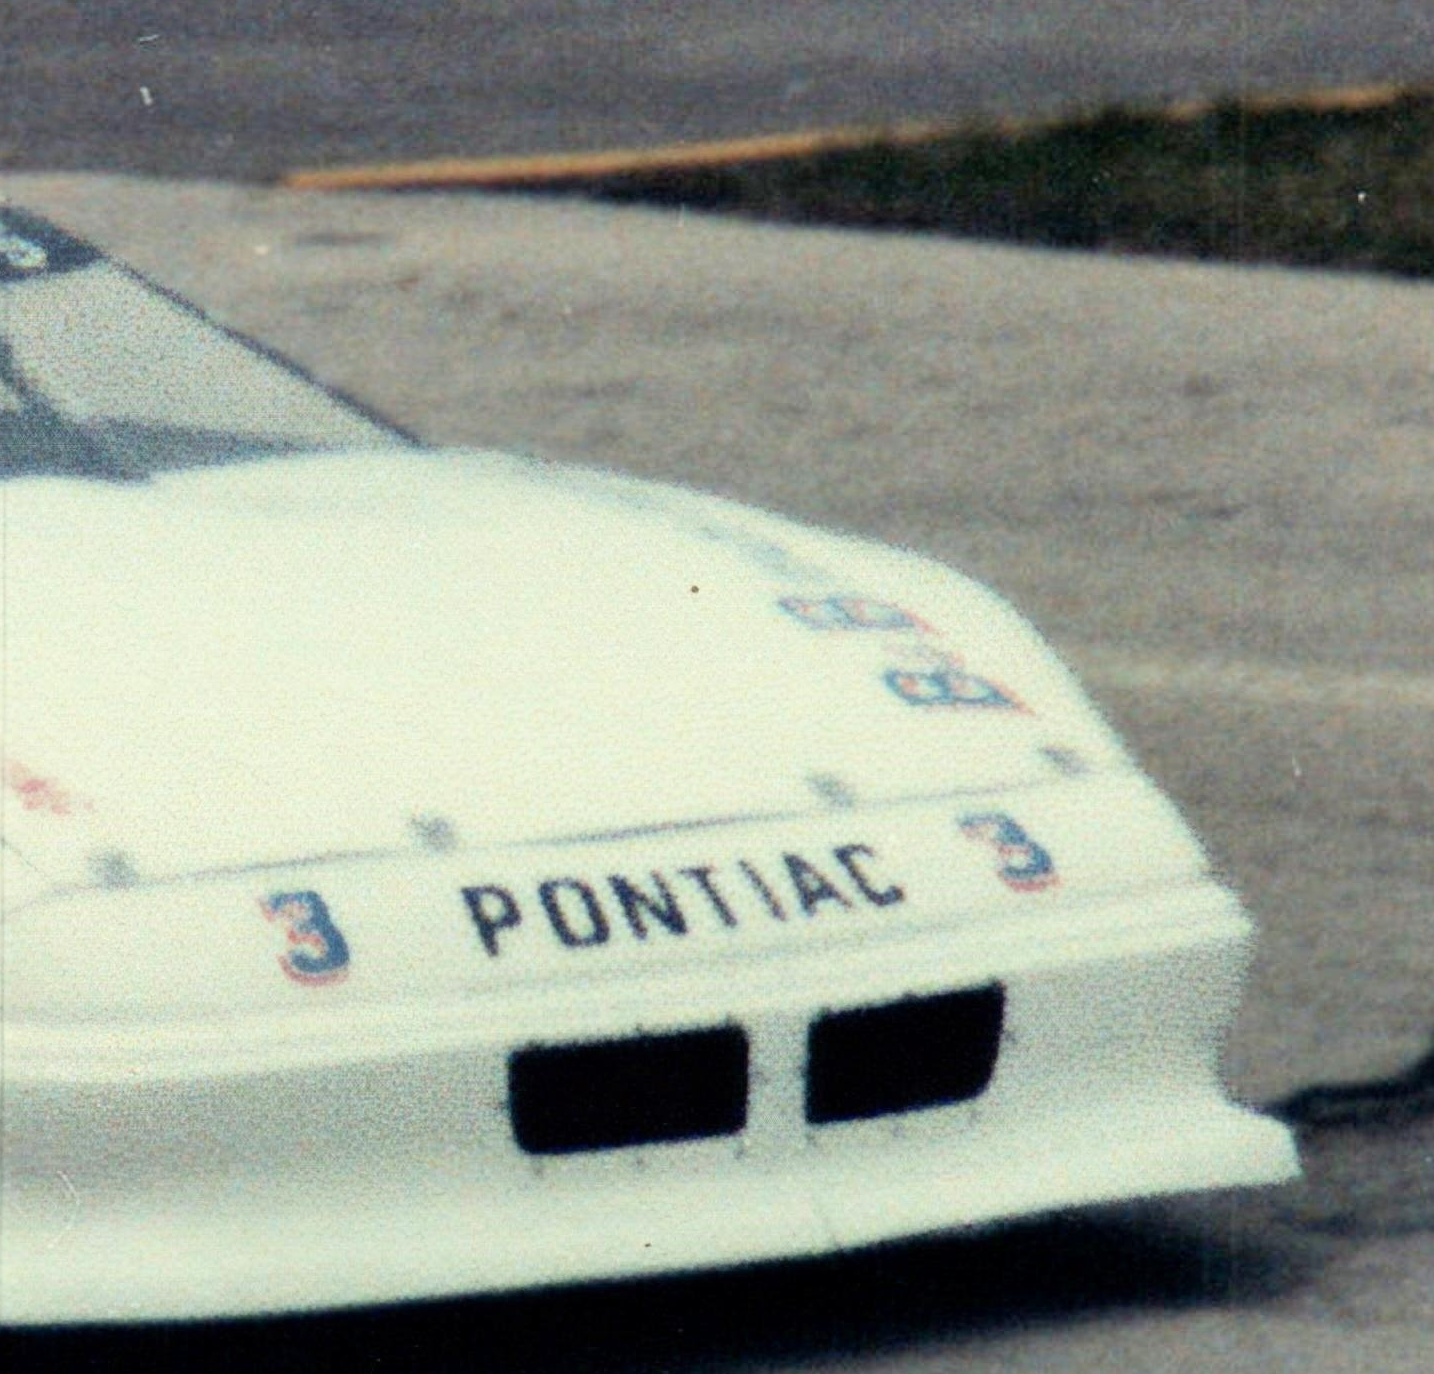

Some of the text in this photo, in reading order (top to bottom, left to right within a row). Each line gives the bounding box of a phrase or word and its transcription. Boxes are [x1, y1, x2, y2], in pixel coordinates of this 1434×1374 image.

[459, 841, 907, 958] PONTIAC
[962, 811, 1060, 893] 3
[257, 889, 352, 987] 3
